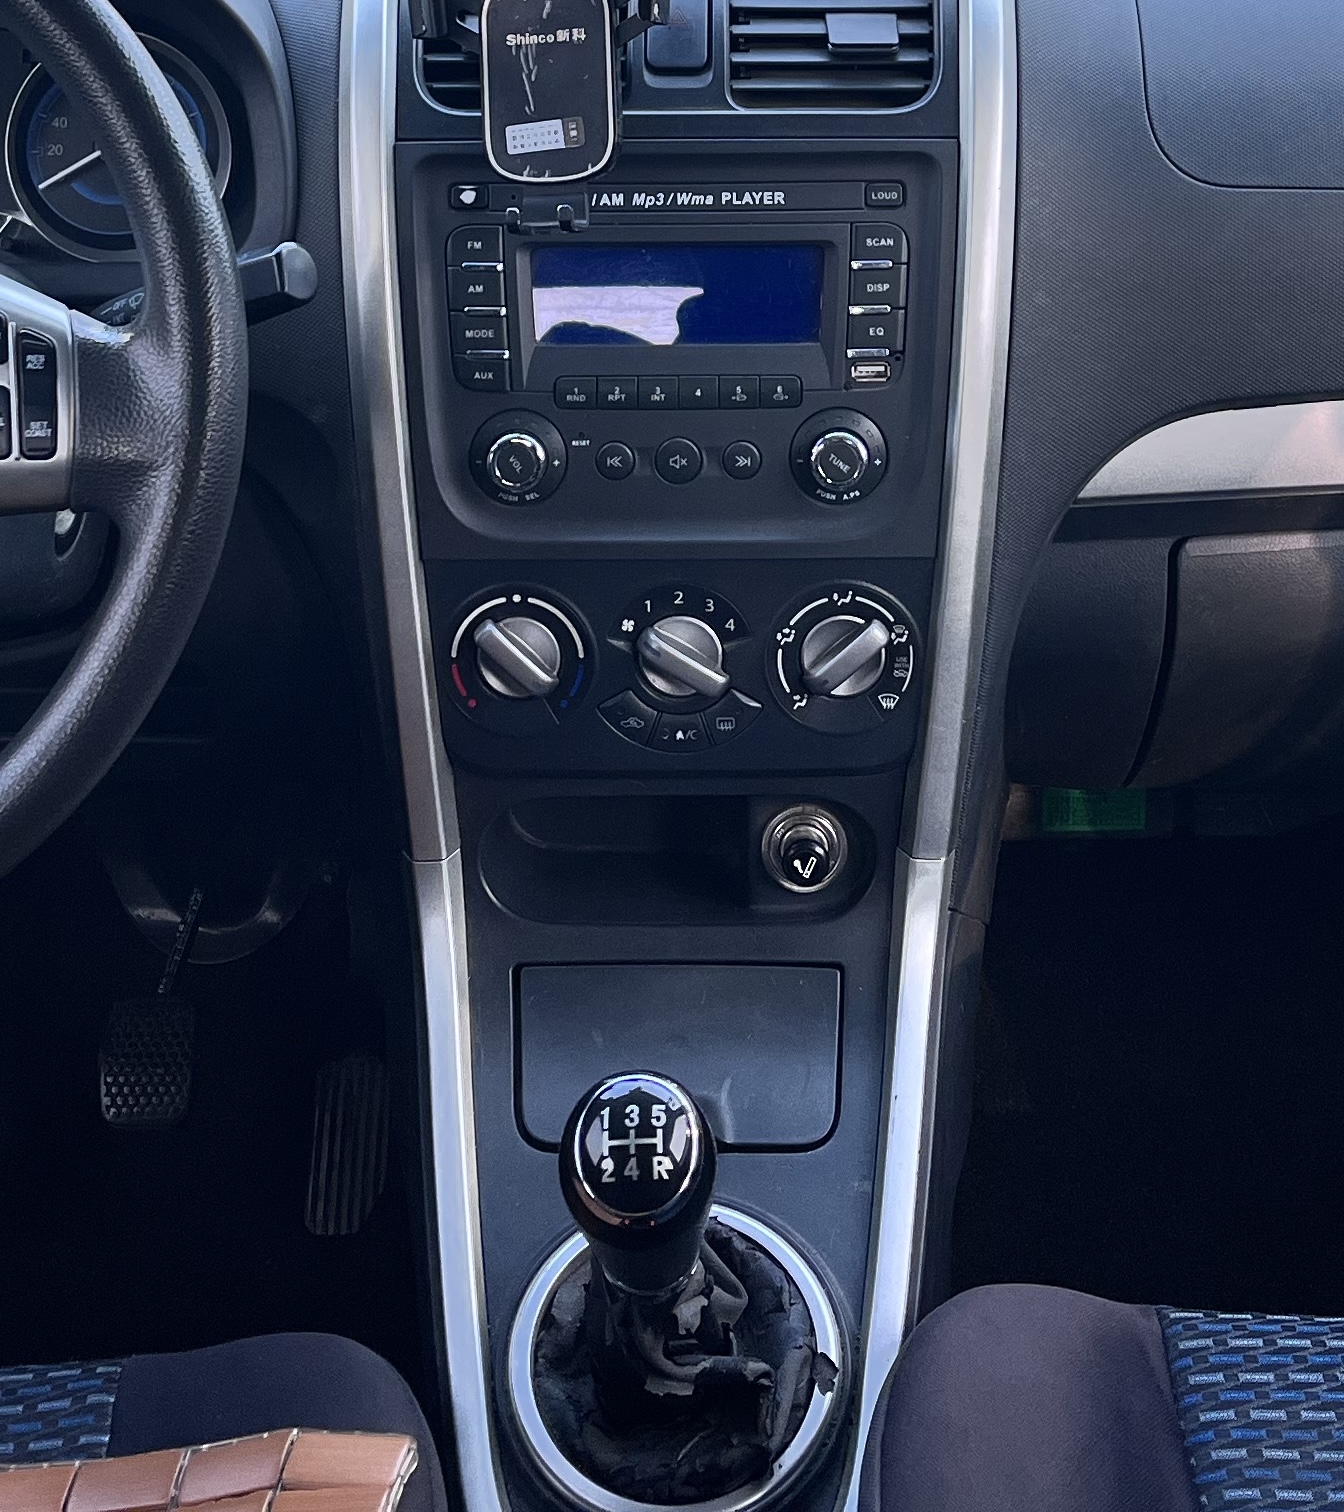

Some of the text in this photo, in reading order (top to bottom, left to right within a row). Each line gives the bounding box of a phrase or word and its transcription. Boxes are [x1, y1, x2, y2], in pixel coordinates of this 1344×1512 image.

[506, 32, 555, 46] Shinco
[51, 116, 68, 128] 40
[47, 144, 63, 156] 20
[721, 191, 785, 206] PLAYER
[871, 191, 898, 201] LOUD
[467, 241, 482, 250] FM
[865, 237, 894, 247] SCAN
[468, 284, 484, 293] AM
[866, 282, 890, 293] DISP
[465, 329, 495, 338] MODE
[869, 326, 885, 338] EQ
[473, 372, 494, 380] AUX
[607, 394, 626, 402] RPT
[695, 388, 702, 397] 4
[508, 454, 523, 474] VOL
[828, 453, 851, 474] TUNE
[816, 488, 837, 500] PUSH
[673, 591, 684, 605] 2
[644, 600, 652, 612] 1
[705, 599, 715, 612] 3
[725, 618, 735, 631] 4
[675, 729, 698, 741] A/C
[600, 1104, 667, 1130] 1 3 5
[600, 1156, 674, 1183] 2 4 R
